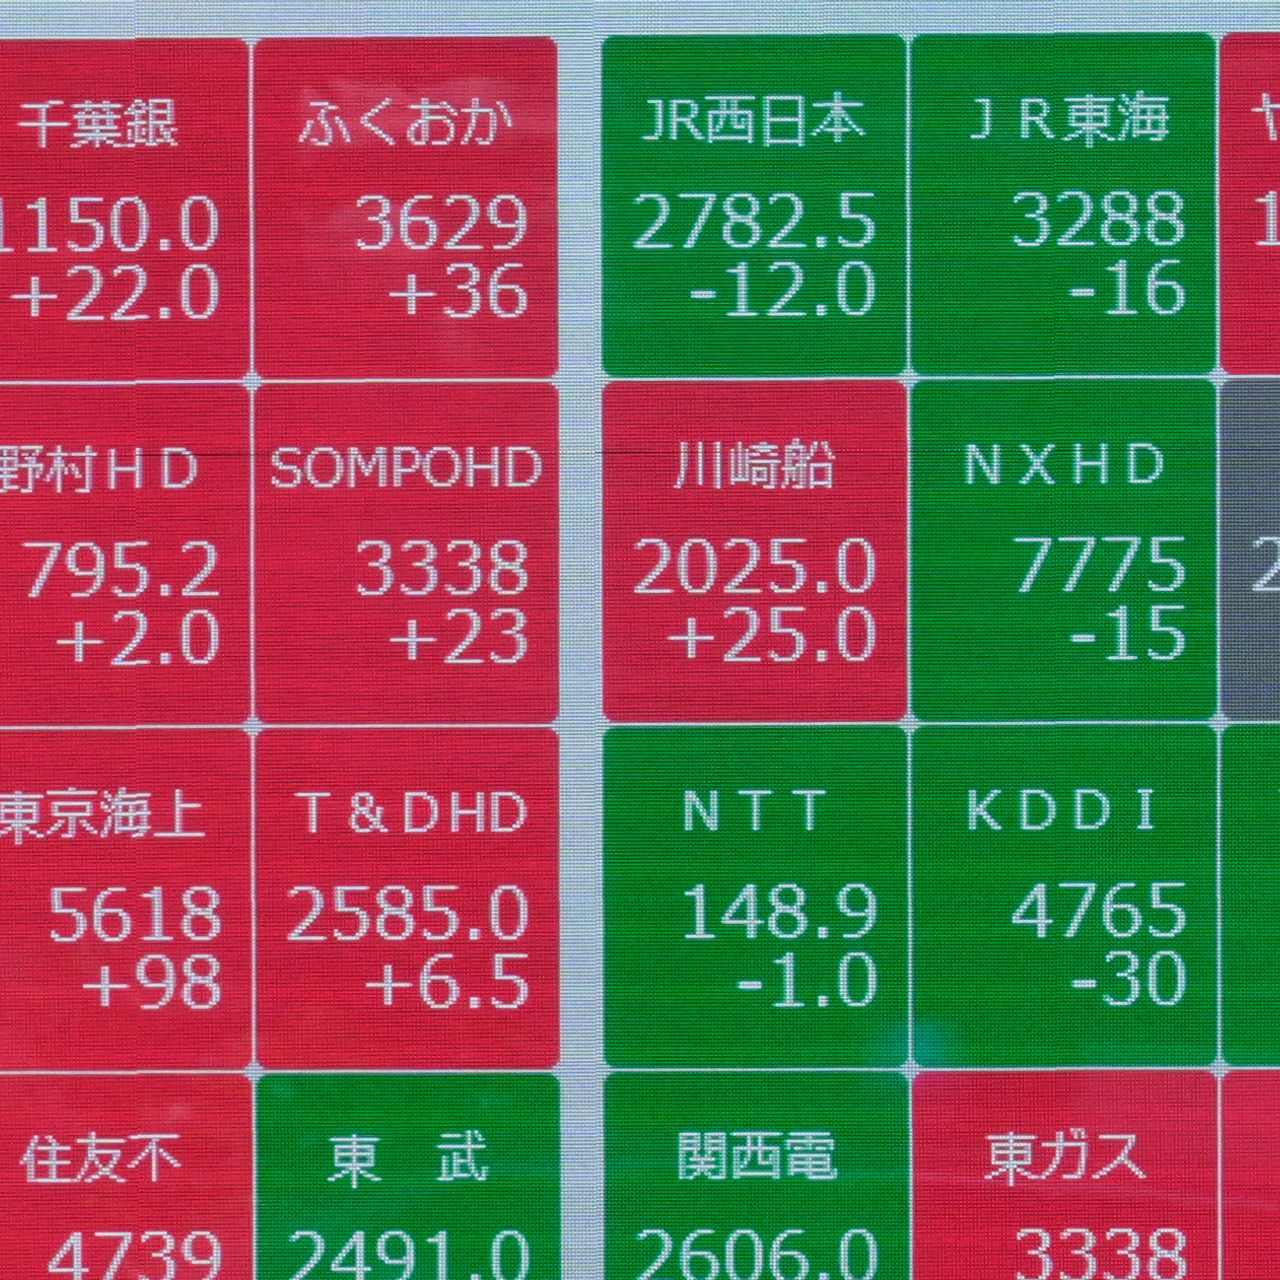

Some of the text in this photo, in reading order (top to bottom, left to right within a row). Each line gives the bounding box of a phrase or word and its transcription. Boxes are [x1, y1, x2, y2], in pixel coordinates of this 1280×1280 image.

[19, 97, 177, 149] 千葉銀
[298, 97, 514, 148] ふくおか
[644, 92, 864, 146] JR西日本
[356, 193, 528, 251] 3629
[634, 191, 875, 249] 2782.5
[1014, 190, 1185, 248] 3288
[12, 263, 220, 322] +22.0
[389, 262, 528, 319] +36
[691, 260, 875, 317] -12.0
[1071, 259, 1186, 316] -16
[271, 445, 543, 489] SOMPOHD
[24, 540, 219, 598] 795.2
[357, 539, 529, 597] 3338
[634, 537, 876, 595] 2025.0
[1016, 535, 1185, 593] 7775
[57, 608, 220, 667] +2.0
[390, 607, 528, 665] +23
[669, 605, 876, 663] +25.0
[1071, 604, 1185, 661] -15
[50, 885, 222, 943] 5618
[288, 884, 529, 942] 2585.0
[686, 883, 877, 940] 148.9
[1012, 881, 1186, 938] 4765
[83, 953, 222, 1010] +98
[366, 952, 529, 1010] +6.5
[738, 951, 877, 1008] -1.0
[1072, 949, 1186, 1007] -30
[20, 1131, 181, 1184] 住友不
[679, 1131, 838, 1181] 関西電
[985, 1127, 1146, 1187] 東ガス
